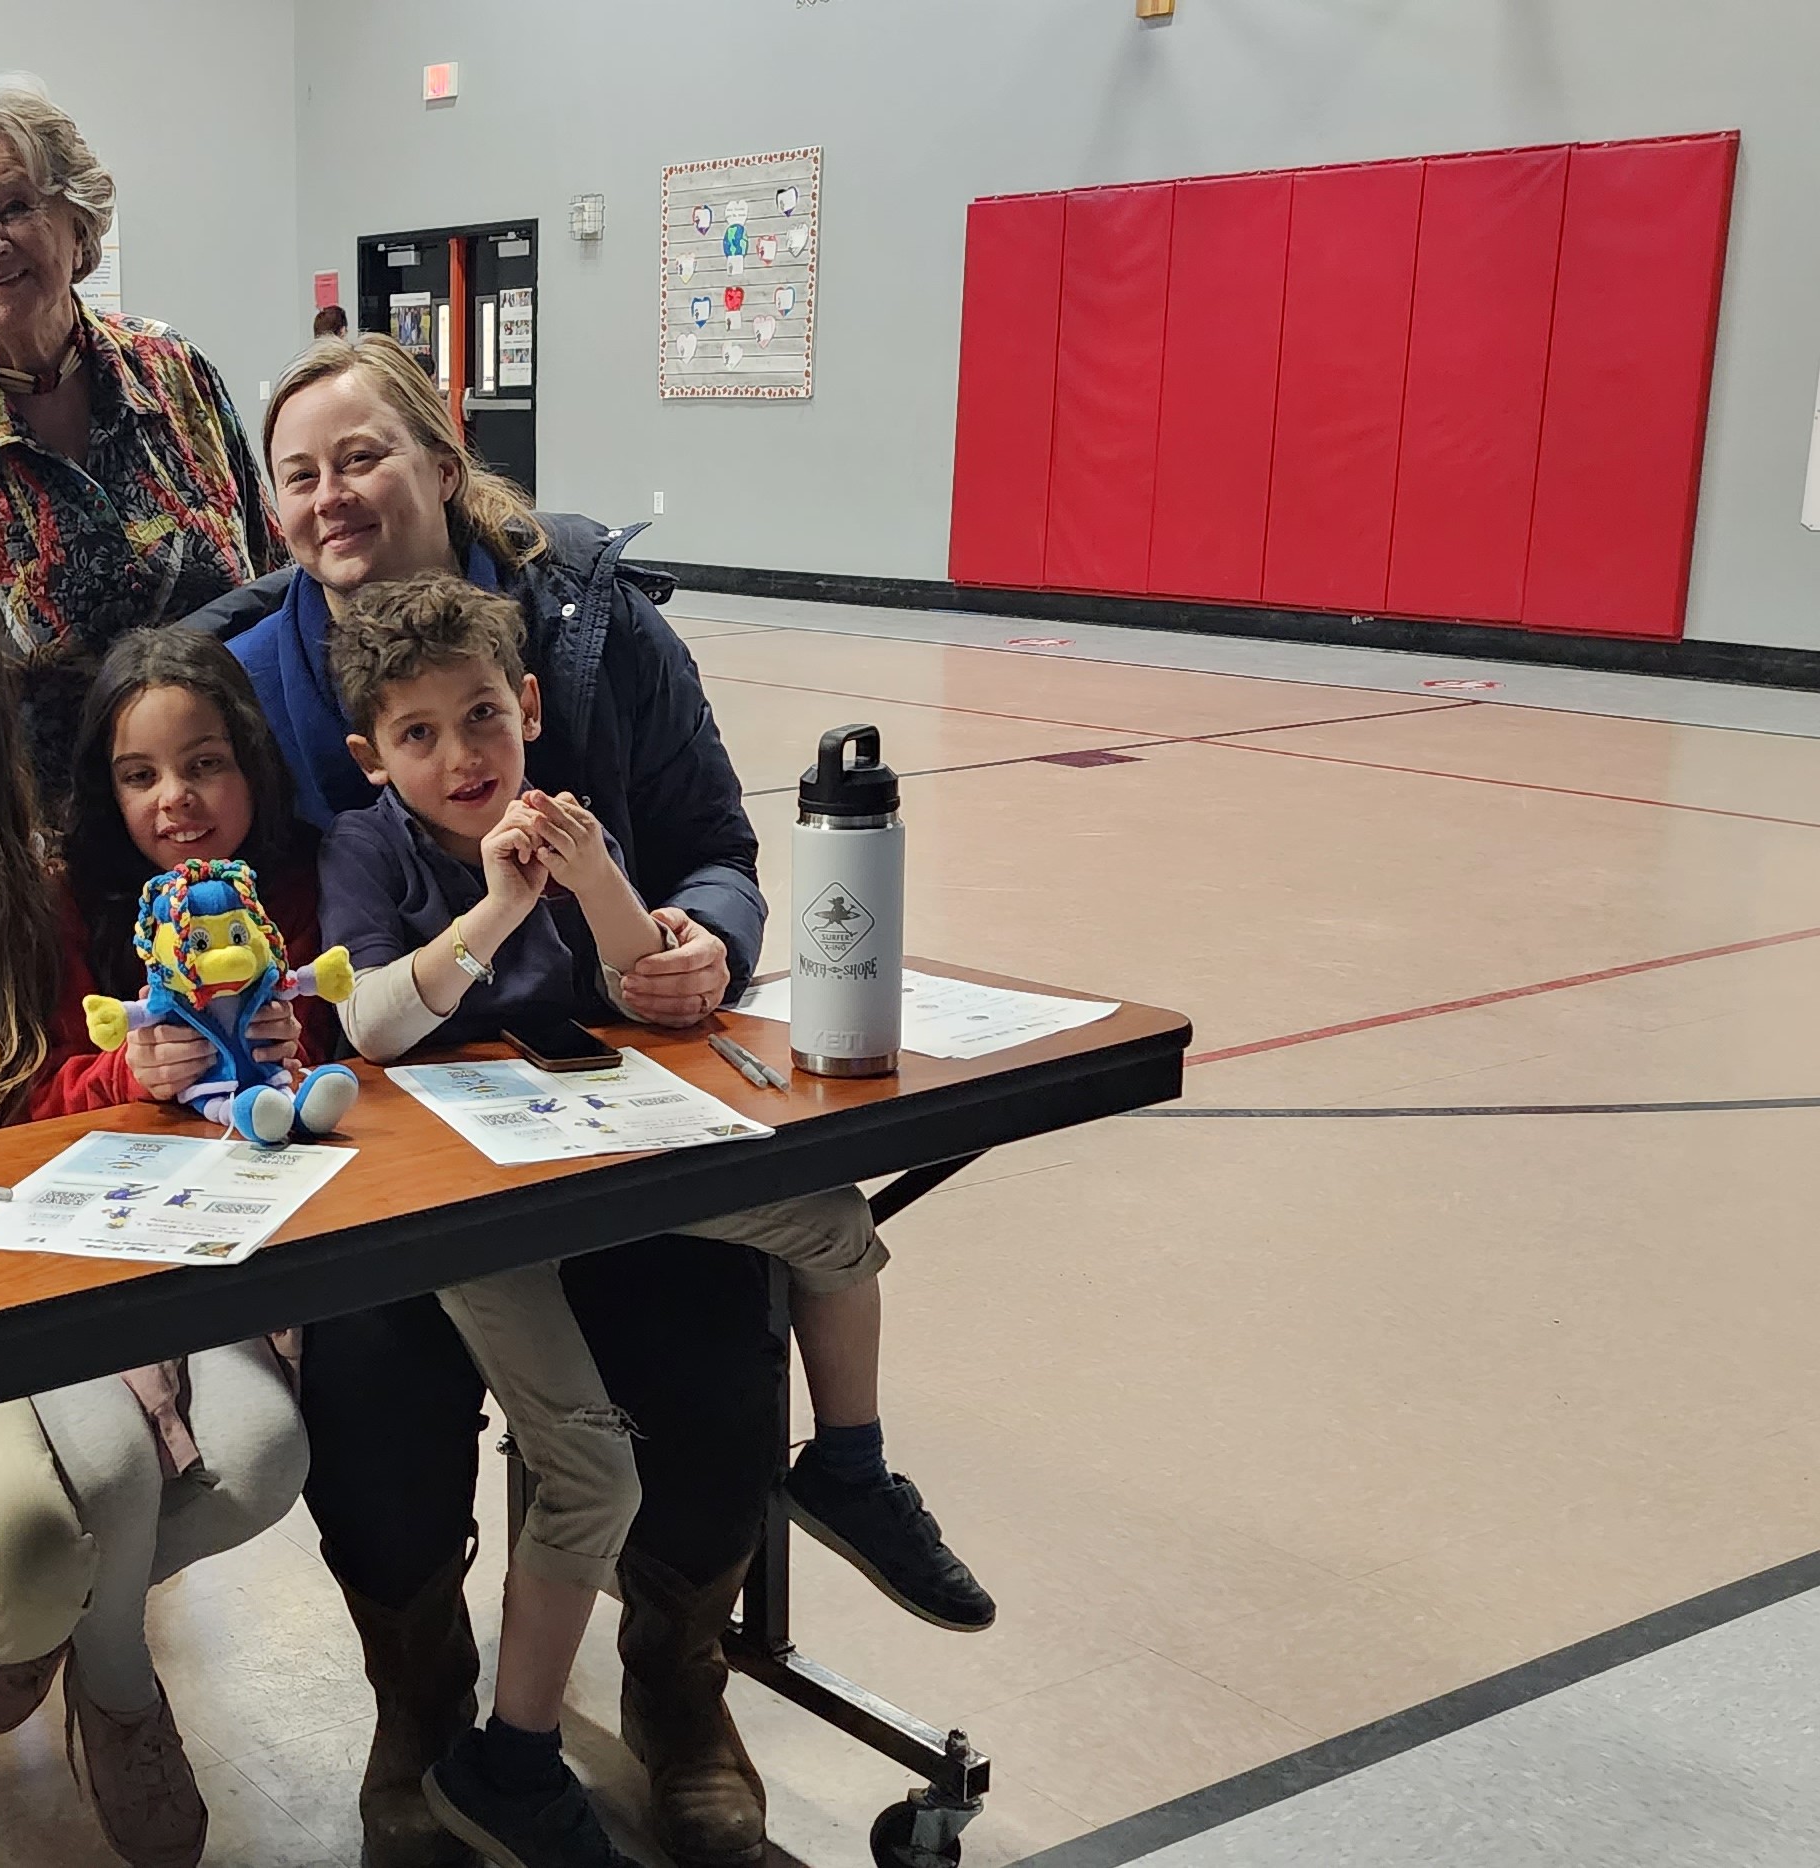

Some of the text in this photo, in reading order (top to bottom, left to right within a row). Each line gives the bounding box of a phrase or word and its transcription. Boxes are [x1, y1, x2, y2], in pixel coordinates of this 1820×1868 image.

[799, 952, 878, 980] NORTH SHORE
[813, 1029, 868, 1052] YETI
